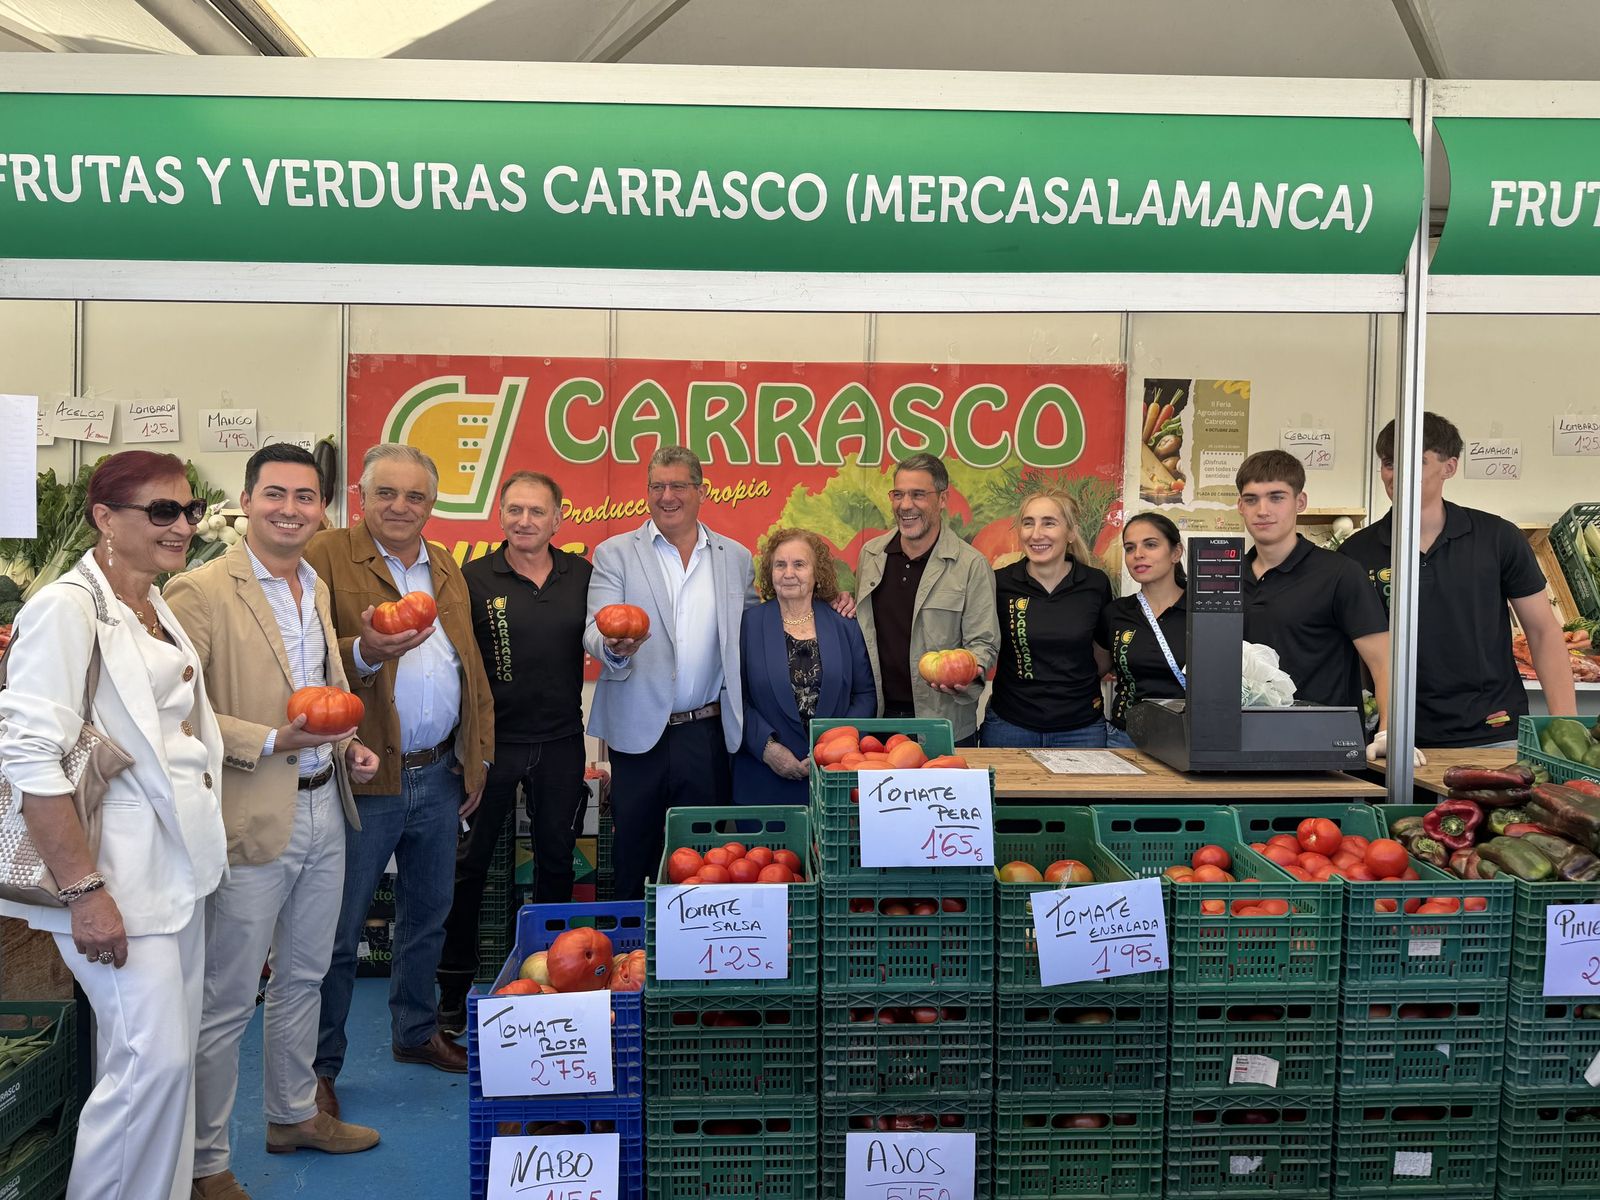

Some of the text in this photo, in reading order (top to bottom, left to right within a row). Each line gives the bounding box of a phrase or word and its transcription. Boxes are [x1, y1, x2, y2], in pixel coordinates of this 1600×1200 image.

[197, 155, 231, 205] Y
[242, 158, 526, 212] VERDURAS
[542, 165, 828, 222] CARRASCO
[845, 172, 1373, 234] (MERCASALAMANCA)
[130, 403, 175, 414] LOMBARDA
[208, 412, 252, 428] MANGO
[545, 377, 1086, 469] CARRASCO
[1470, 442, 1518, 455] ZANAHORIA
[496, 609, 513, 682] CARRASCO
[1016, 610, 1034, 679] CARRASCO
[868, 776, 957, 803] TOMATE
[927, 804, 982, 822] PERA
[667, 886, 741, 924] TOMATE
[1045, 895, 1131, 932] TOMATE
[712, 920, 762, 932] SALSA
[1089, 919, 1159, 938] ENSALADA
[482, 1005, 578, 1039] TOMATE
[538, 1037, 587, 1051] ROSA
[510, 1145, 593, 1187] NABO
[867, 1139, 945, 1175] AJOS
